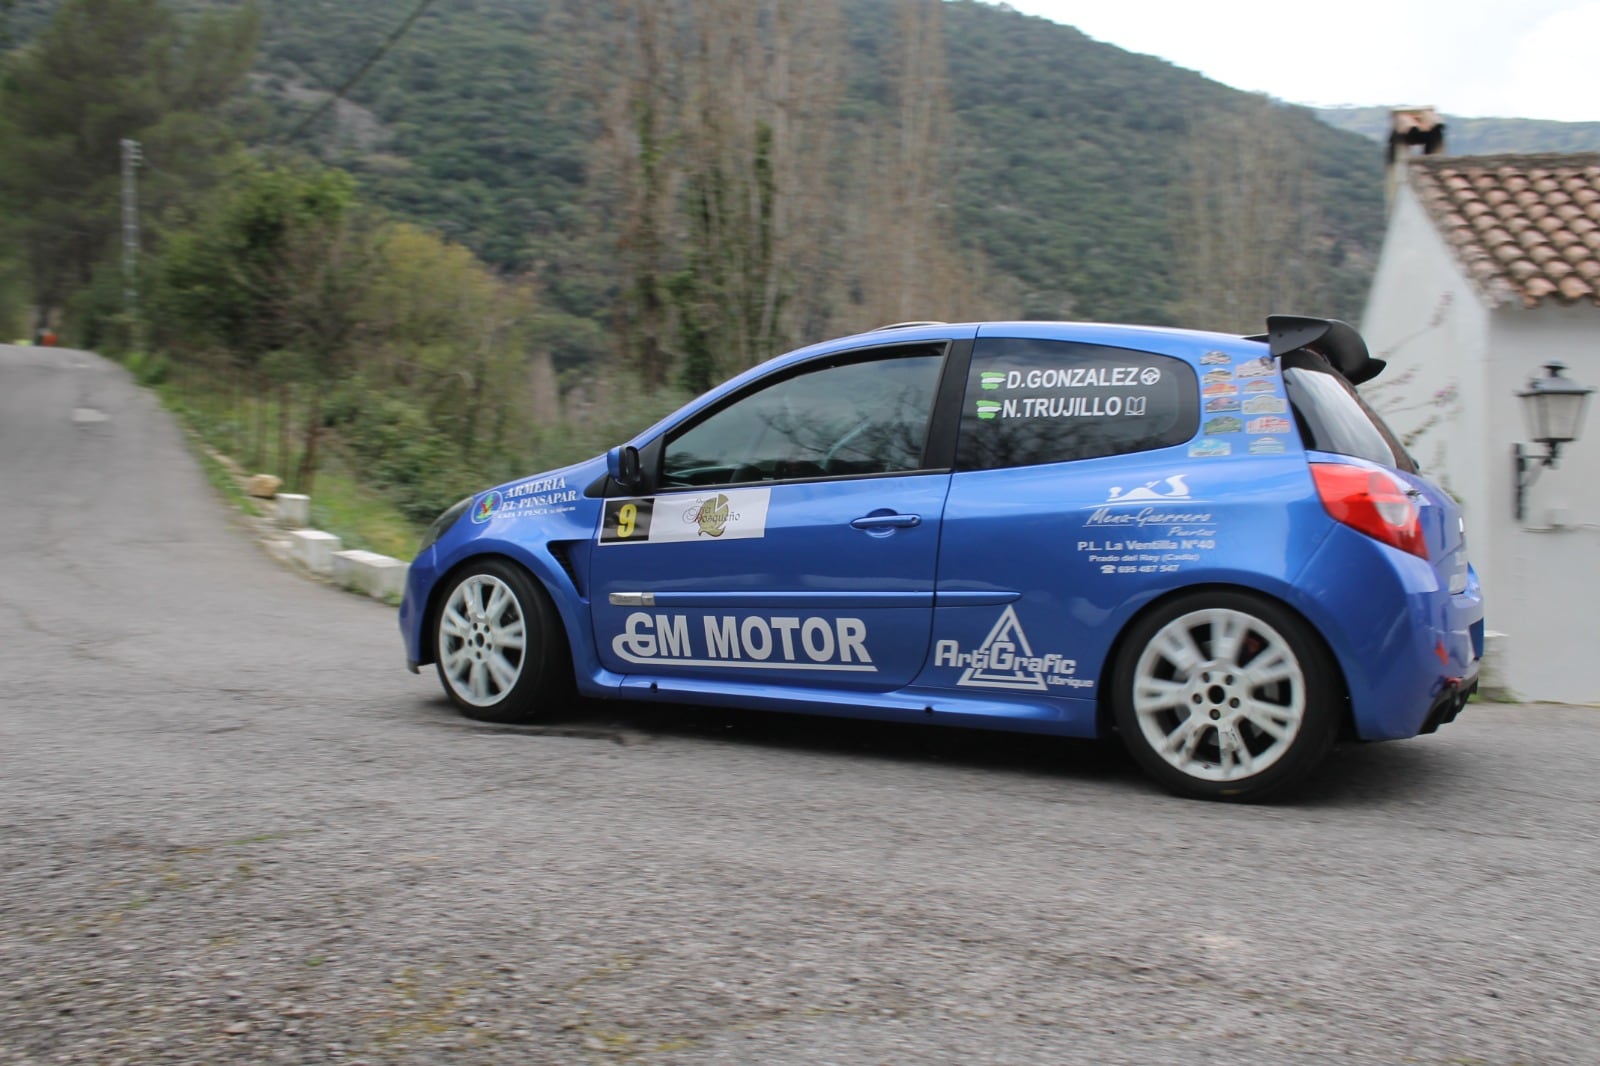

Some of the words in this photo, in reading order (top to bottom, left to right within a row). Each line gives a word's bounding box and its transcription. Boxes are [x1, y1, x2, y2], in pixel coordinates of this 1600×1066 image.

[1006, 367, 1139, 389] D.GONZALEZ
[1002, 396, 1122, 418] N.TRUJILLO
[504, 477, 566, 499] ARMERIA
[501, 501, 516, 512] EL
[518, 489, 577, 509] PINSAPAR
[617, 503, 637, 538] 9
[1105, 541, 1123, 550] La
[1089, 554, 1120, 562] Prado
[1121, 554, 1138, 562] del
[1139, 553, 1160, 563] Rey
[620, 612, 692, 657] GM
[703, 615, 873, 663] MOTOR
[934, 640, 1077, 675] ArtiGrafic
